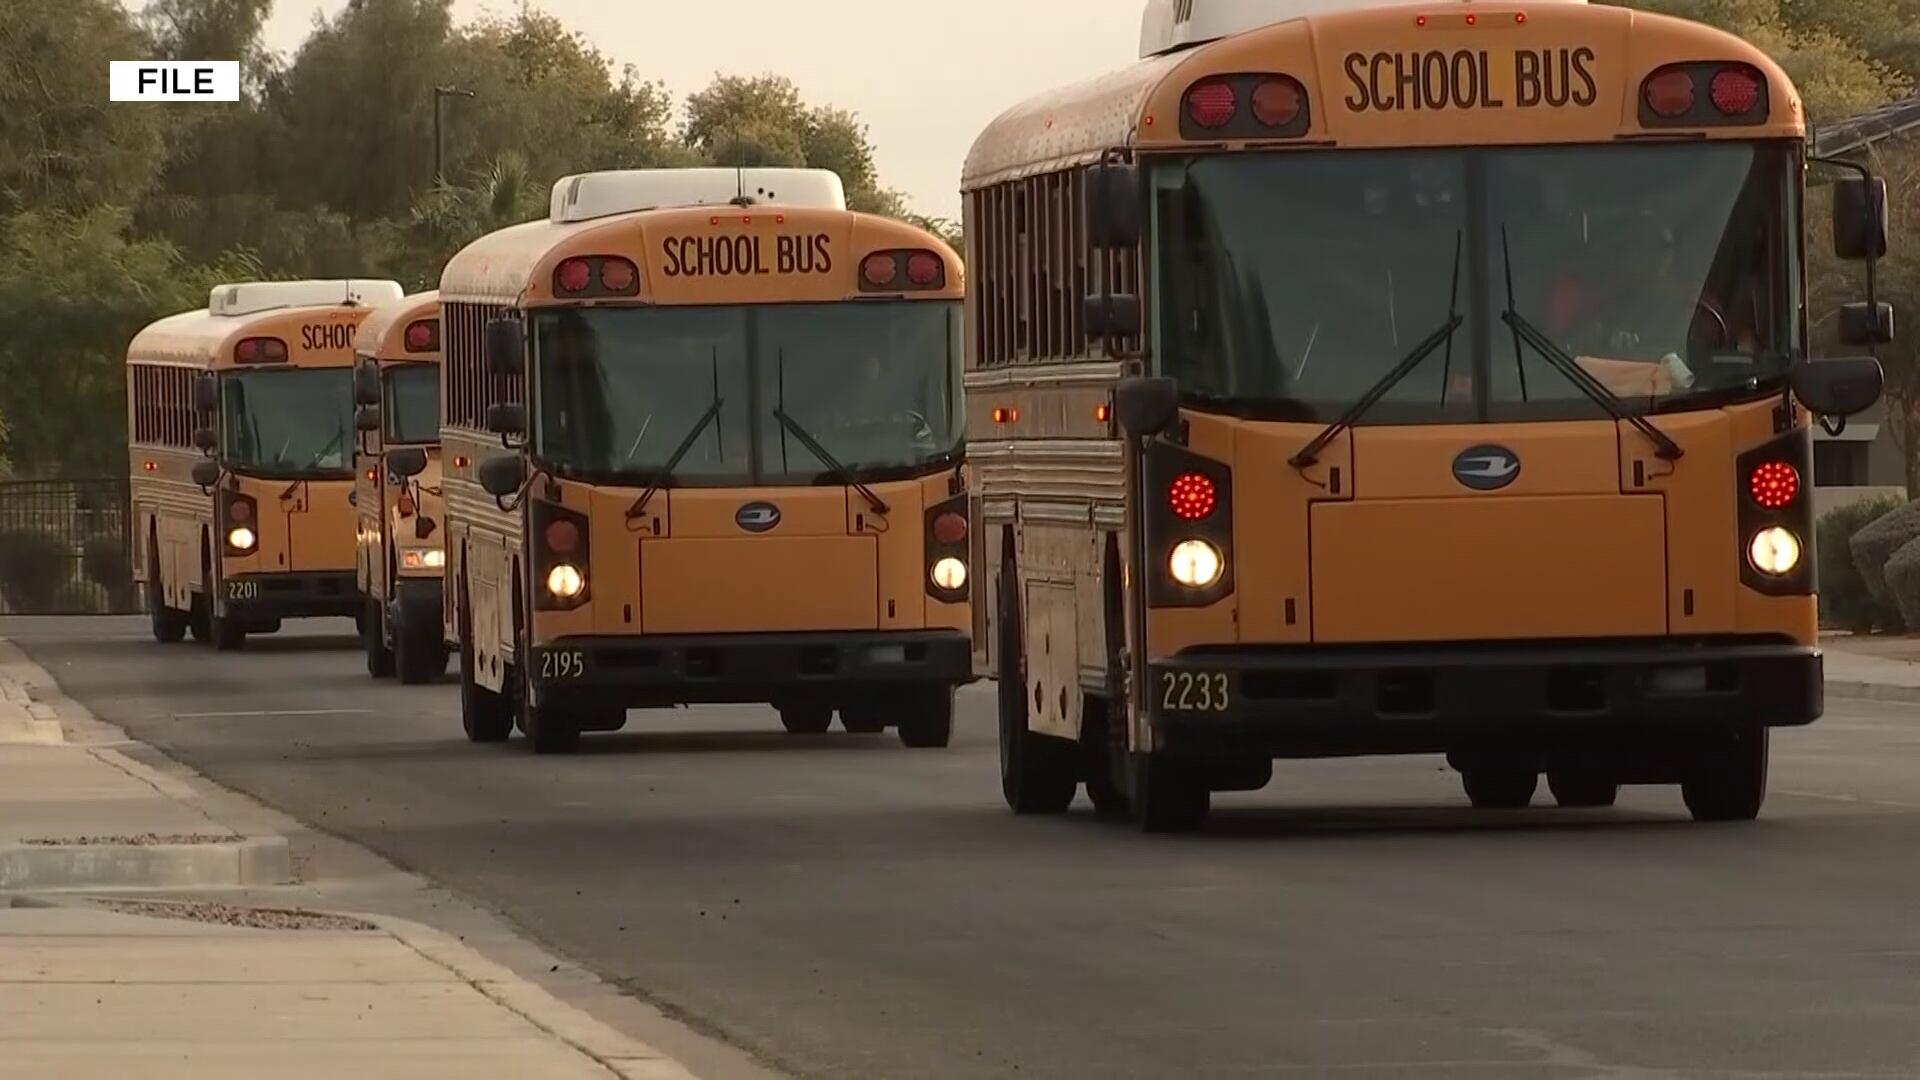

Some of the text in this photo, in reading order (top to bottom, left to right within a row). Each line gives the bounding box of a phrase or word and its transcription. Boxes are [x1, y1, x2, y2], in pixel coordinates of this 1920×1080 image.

[1344, 46, 1597, 112] SCHOOL BUS
[662, 233, 832, 276] SCHOOL BUS
[229, 582, 257, 599] 2201
[542, 652, 583, 677] 2195
[1163, 672, 1228, 710] 2233
